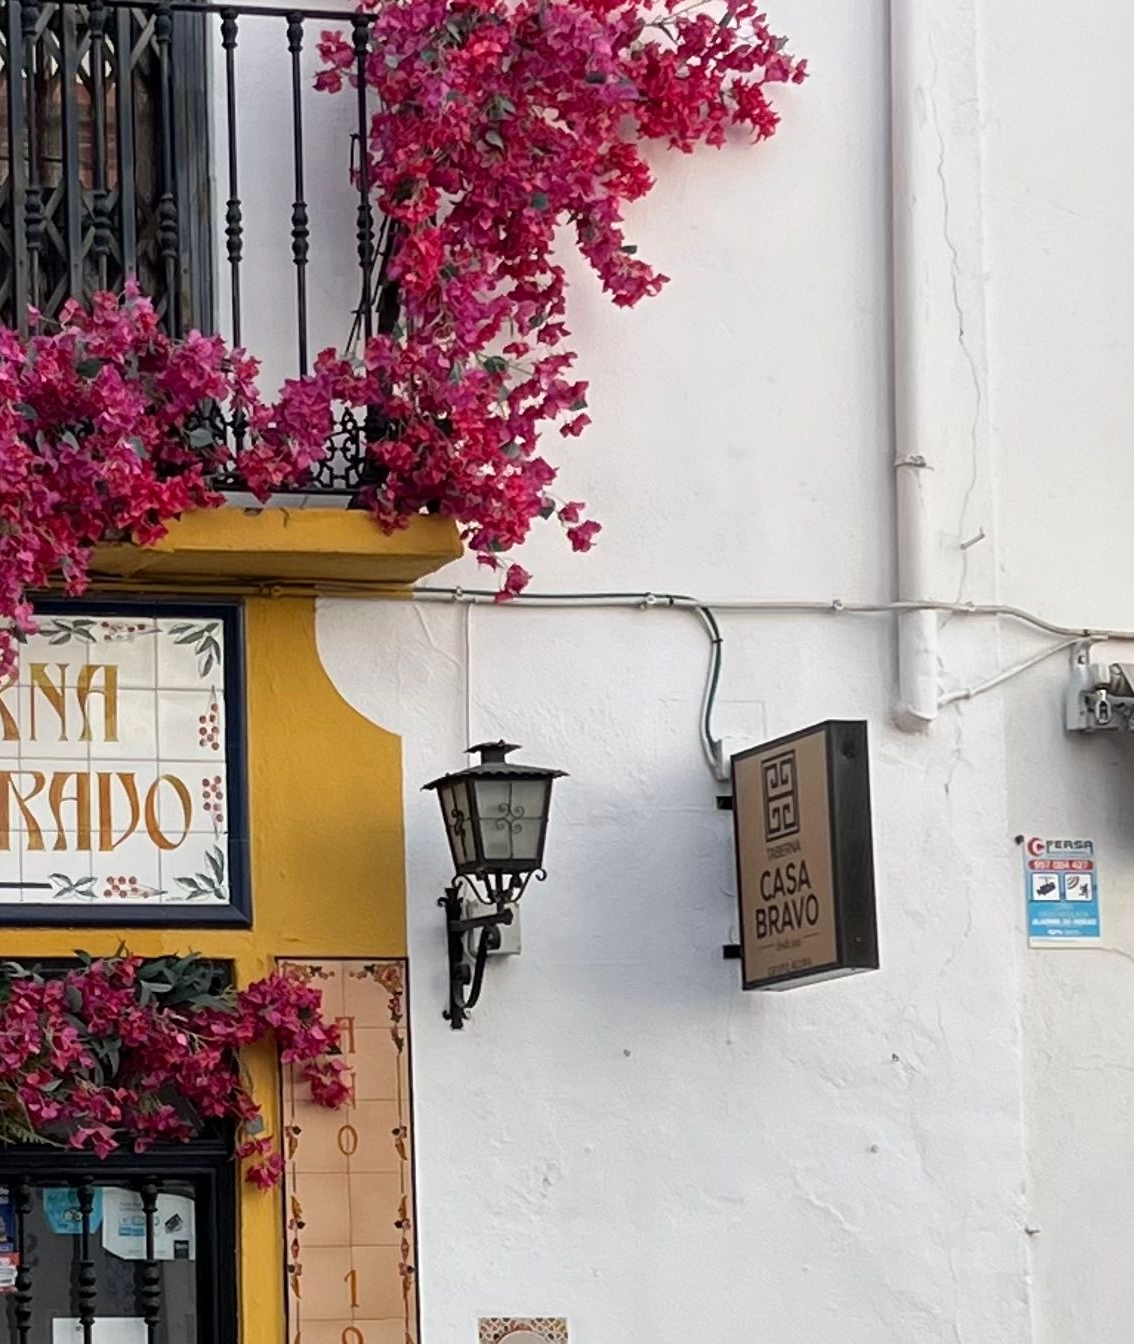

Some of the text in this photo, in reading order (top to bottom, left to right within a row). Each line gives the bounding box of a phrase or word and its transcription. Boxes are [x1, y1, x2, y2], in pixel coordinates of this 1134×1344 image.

[760, 859, 812, 902] CASA
[755, 893, 819, 940] BRAVO
[334, 1016, 359, 1156] AO
